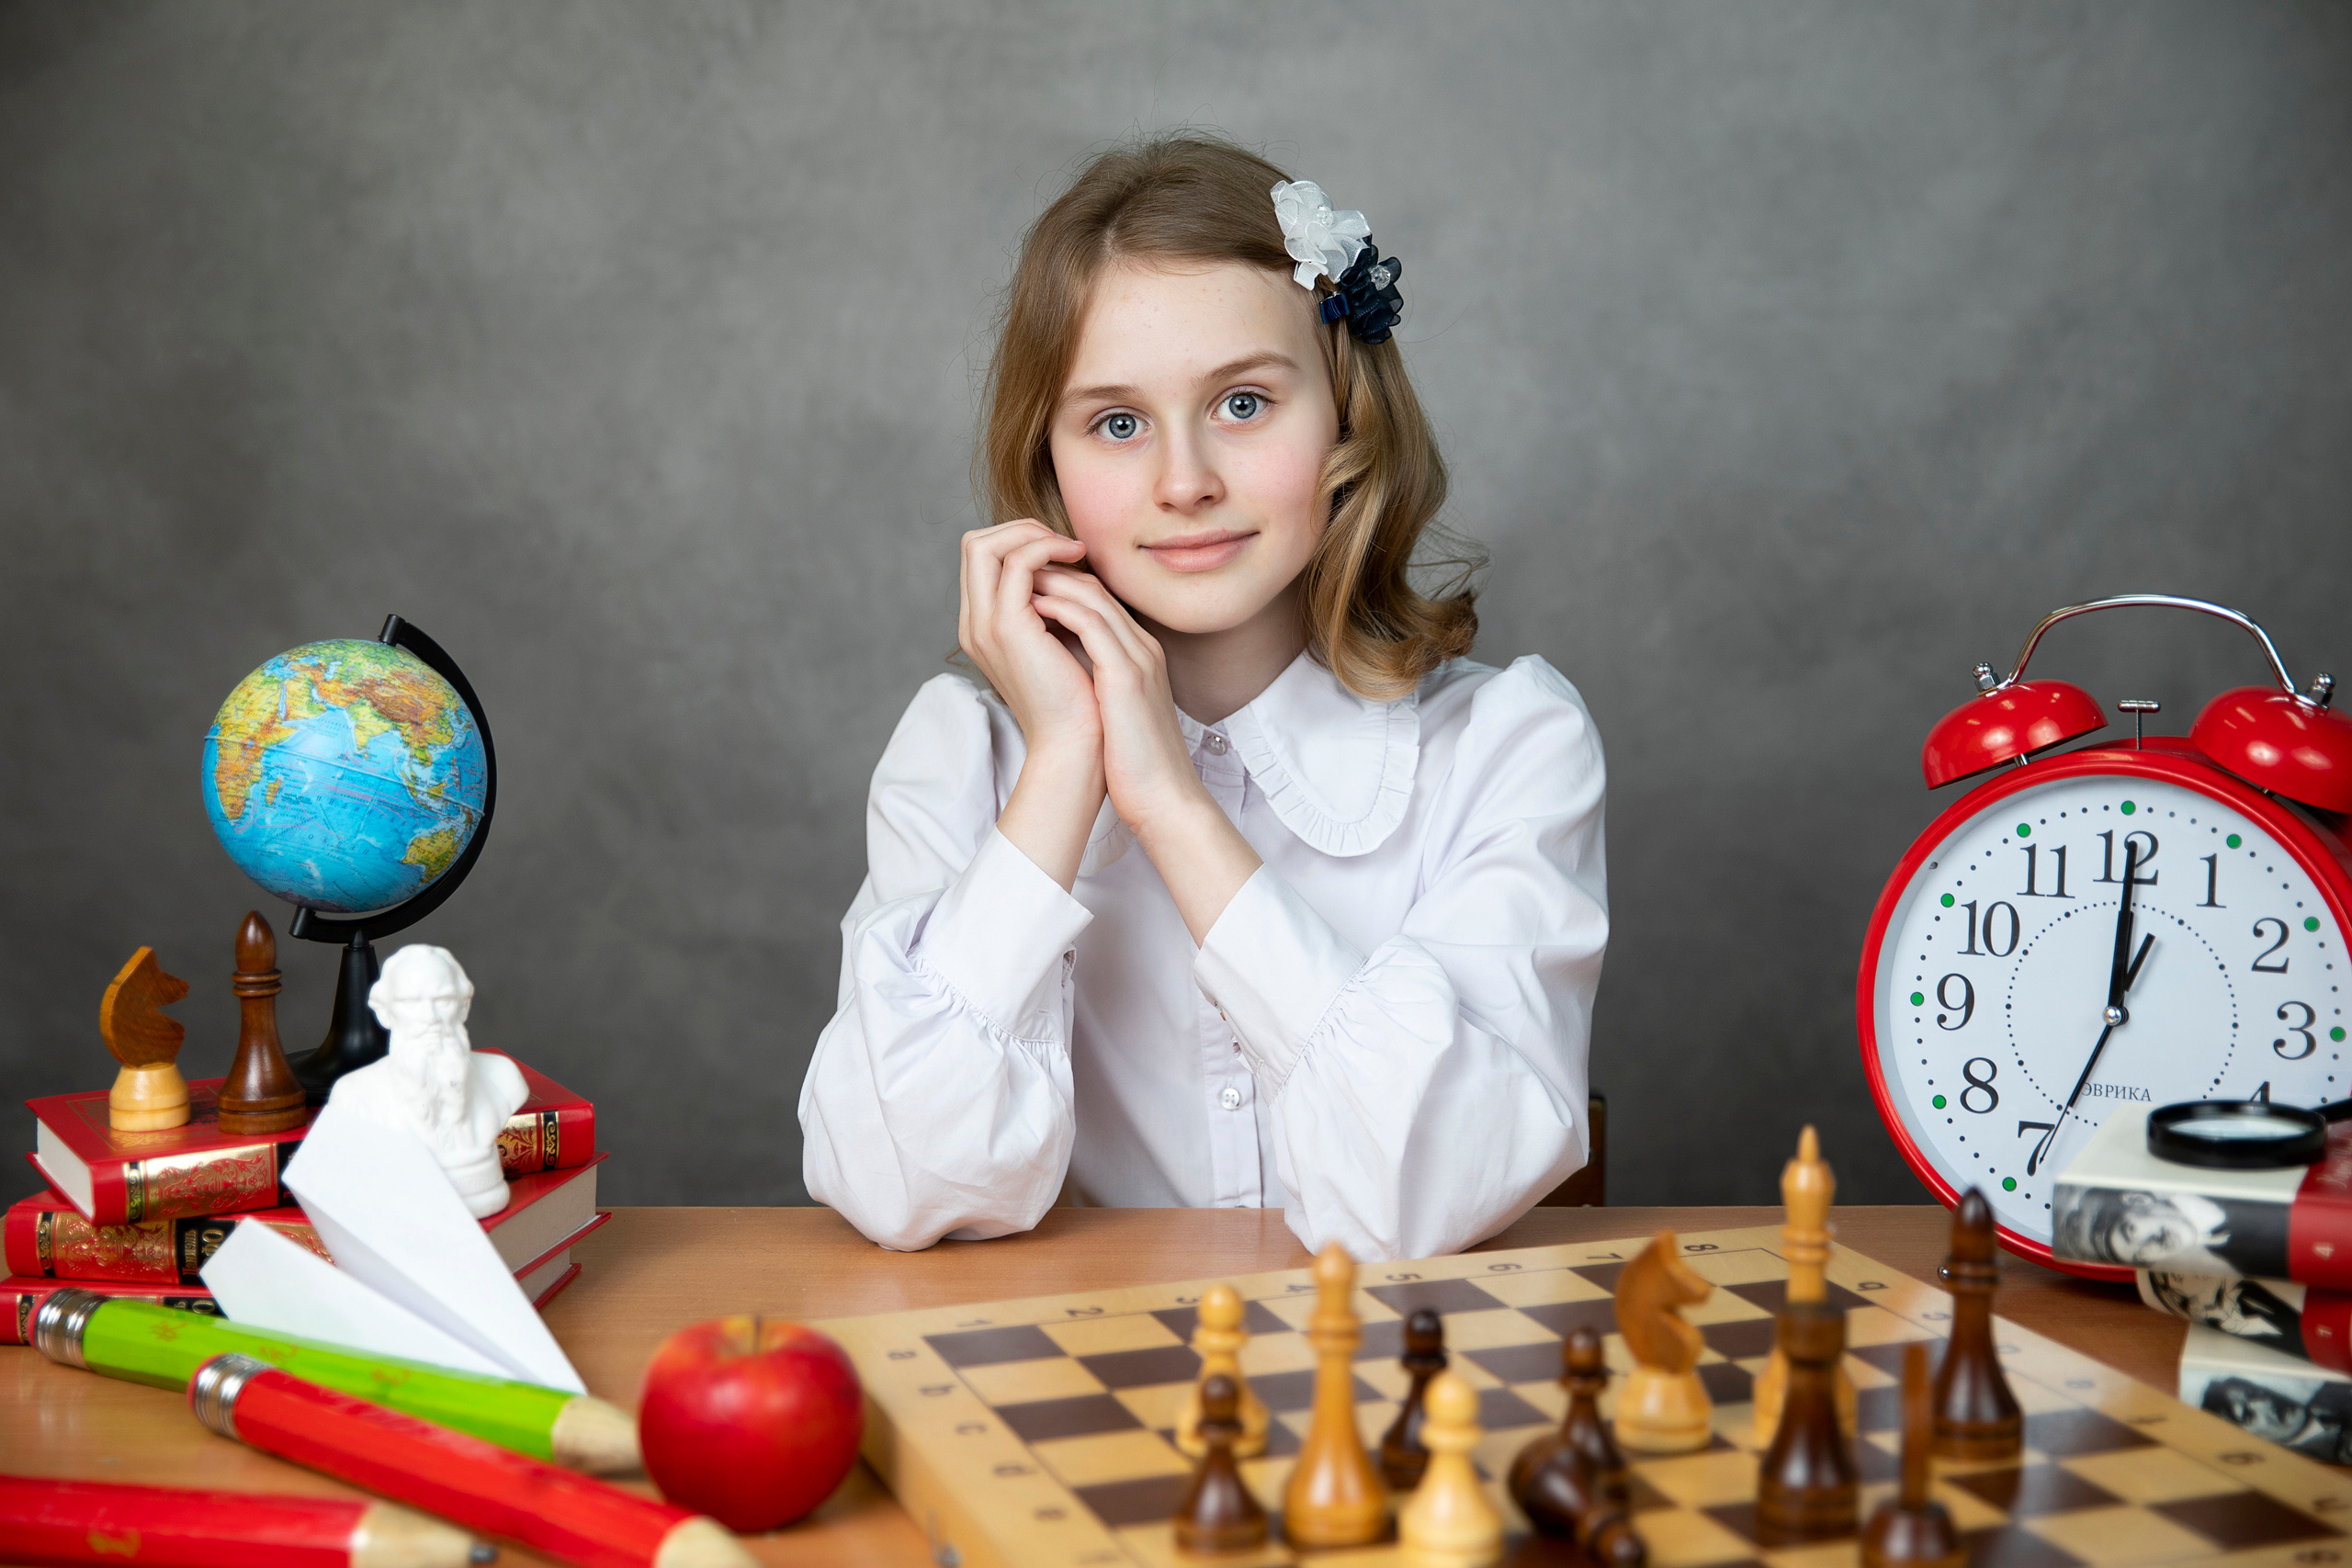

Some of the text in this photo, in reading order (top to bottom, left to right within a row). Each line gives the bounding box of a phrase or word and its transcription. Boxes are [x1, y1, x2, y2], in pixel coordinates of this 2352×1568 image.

[2017, 843, 2075, 899] 11
[2093, 829, 2160, 886] 12
[2196, 852, 2227, 908] 1
[1957, 899, 2020, 958] 10
[2251, 918, 2291, 974] 2
[1936, 974, 1975, 1031] 9
[2273, 1000, 2317, 1060] 3
[1960, 1057, 1999, 1114] 8
[2081, 1082, 2152, 1101] ЭВРИКА
[2018, 1121, 2056, 1177] 7
[1586, 1253, 1623, 1261] 7
[1684, 1244, 1719, 1252] 8
[1385, 1273, 1422, 1282] 5
[1066, 1307, 1104, 1320] 2
